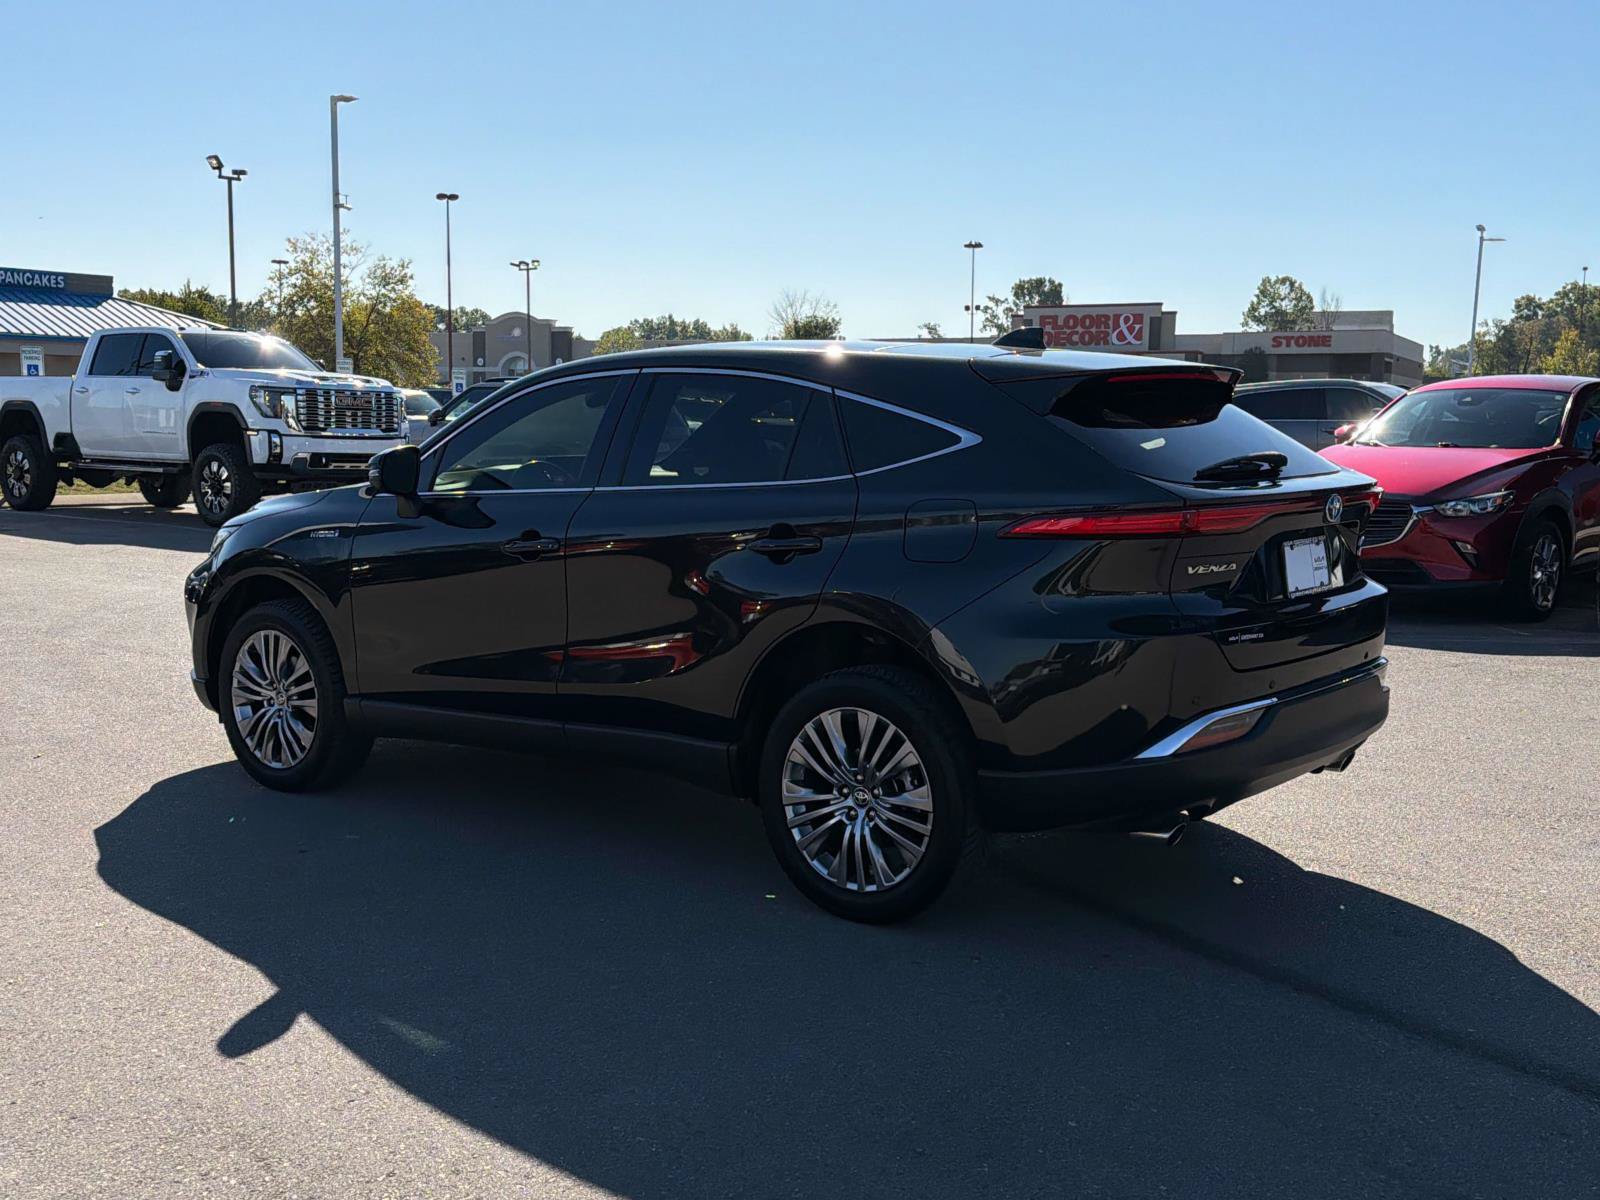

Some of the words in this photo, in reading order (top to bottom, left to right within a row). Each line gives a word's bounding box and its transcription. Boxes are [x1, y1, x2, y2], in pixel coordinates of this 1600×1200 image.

[0, 270, 65, 288] PANCAKES
[1039, 314, 1111, 331] FLOOR
[1043, 330, 1111, 346] DECOR
[1271, 336, 1332, 348] STONE
[335, 395, 373, 408] GMC
[1187, 562, 1237, 575] VENZA
